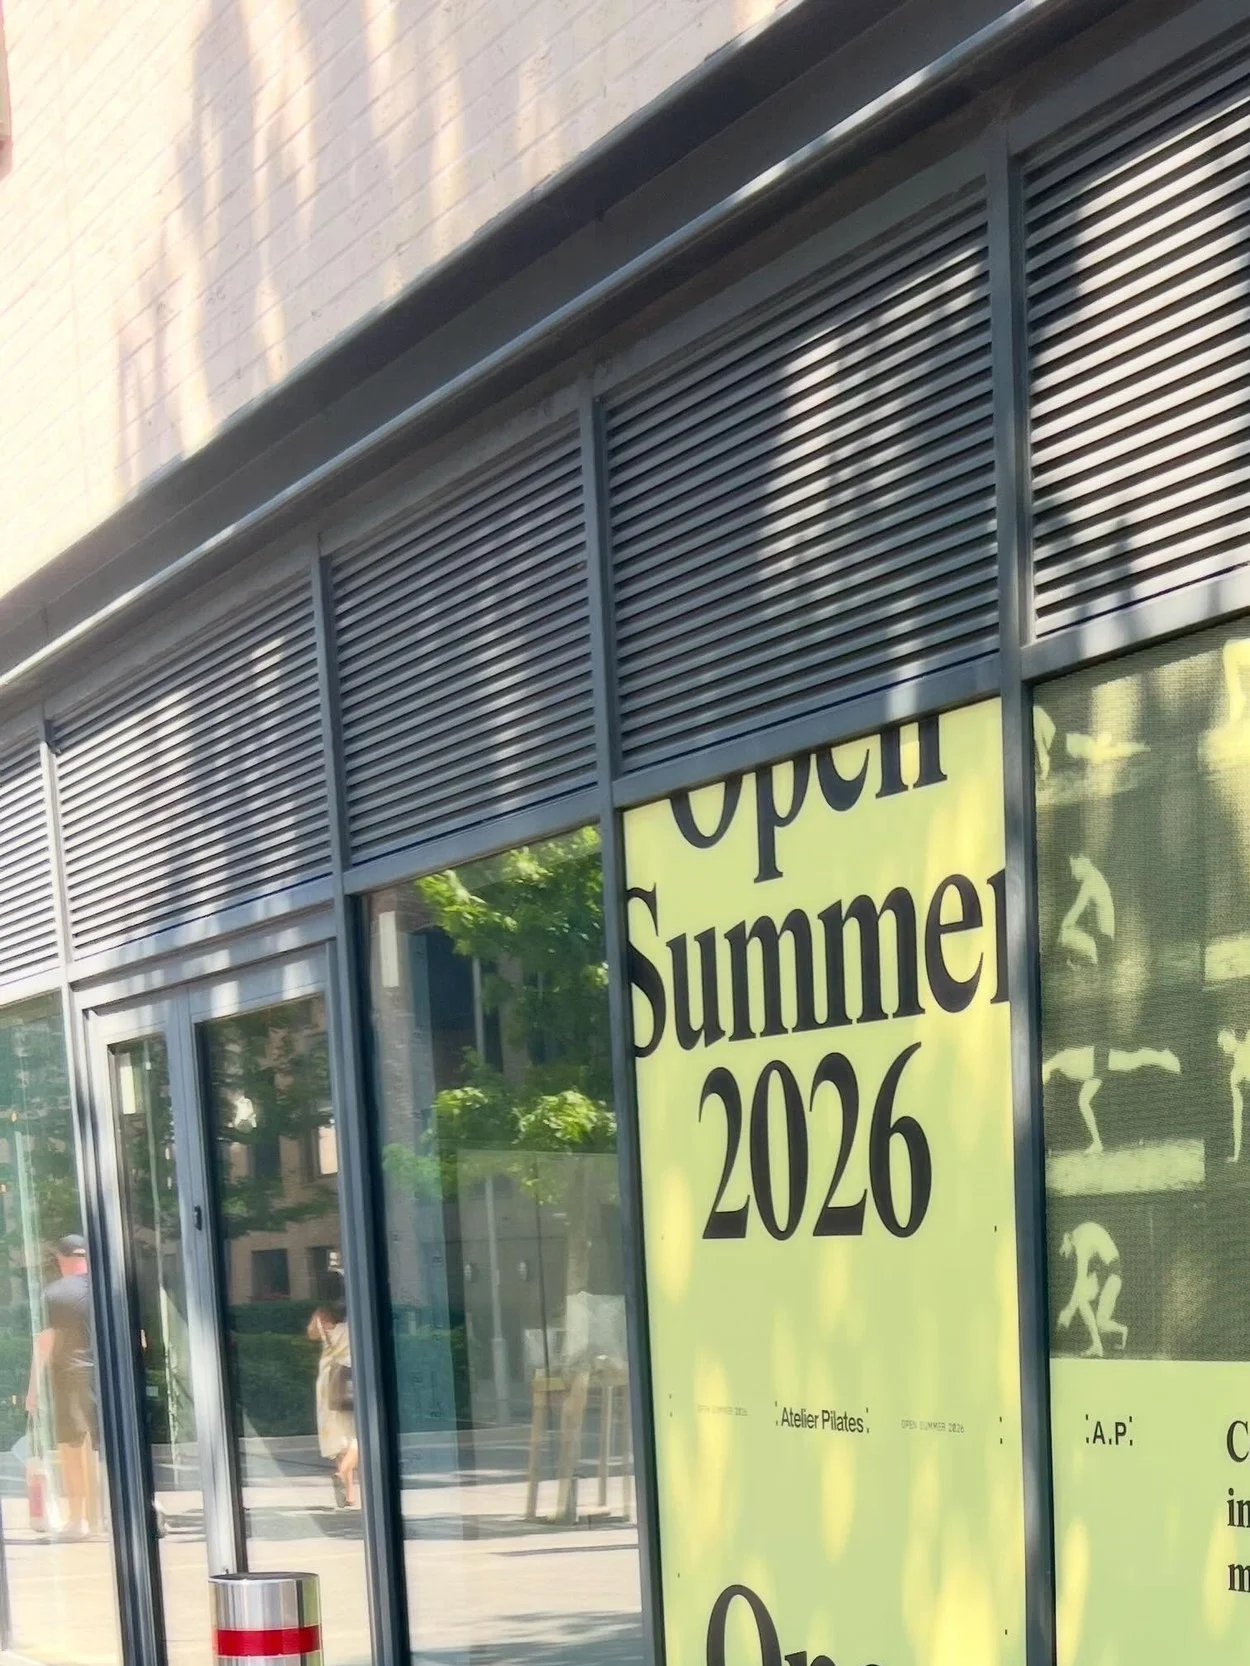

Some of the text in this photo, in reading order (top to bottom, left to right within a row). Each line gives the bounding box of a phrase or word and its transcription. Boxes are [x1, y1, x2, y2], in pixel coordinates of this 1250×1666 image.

[698, 1041, 932, 1241] 2026
[781, 1407, 864, 1434] Atelier Pilates
